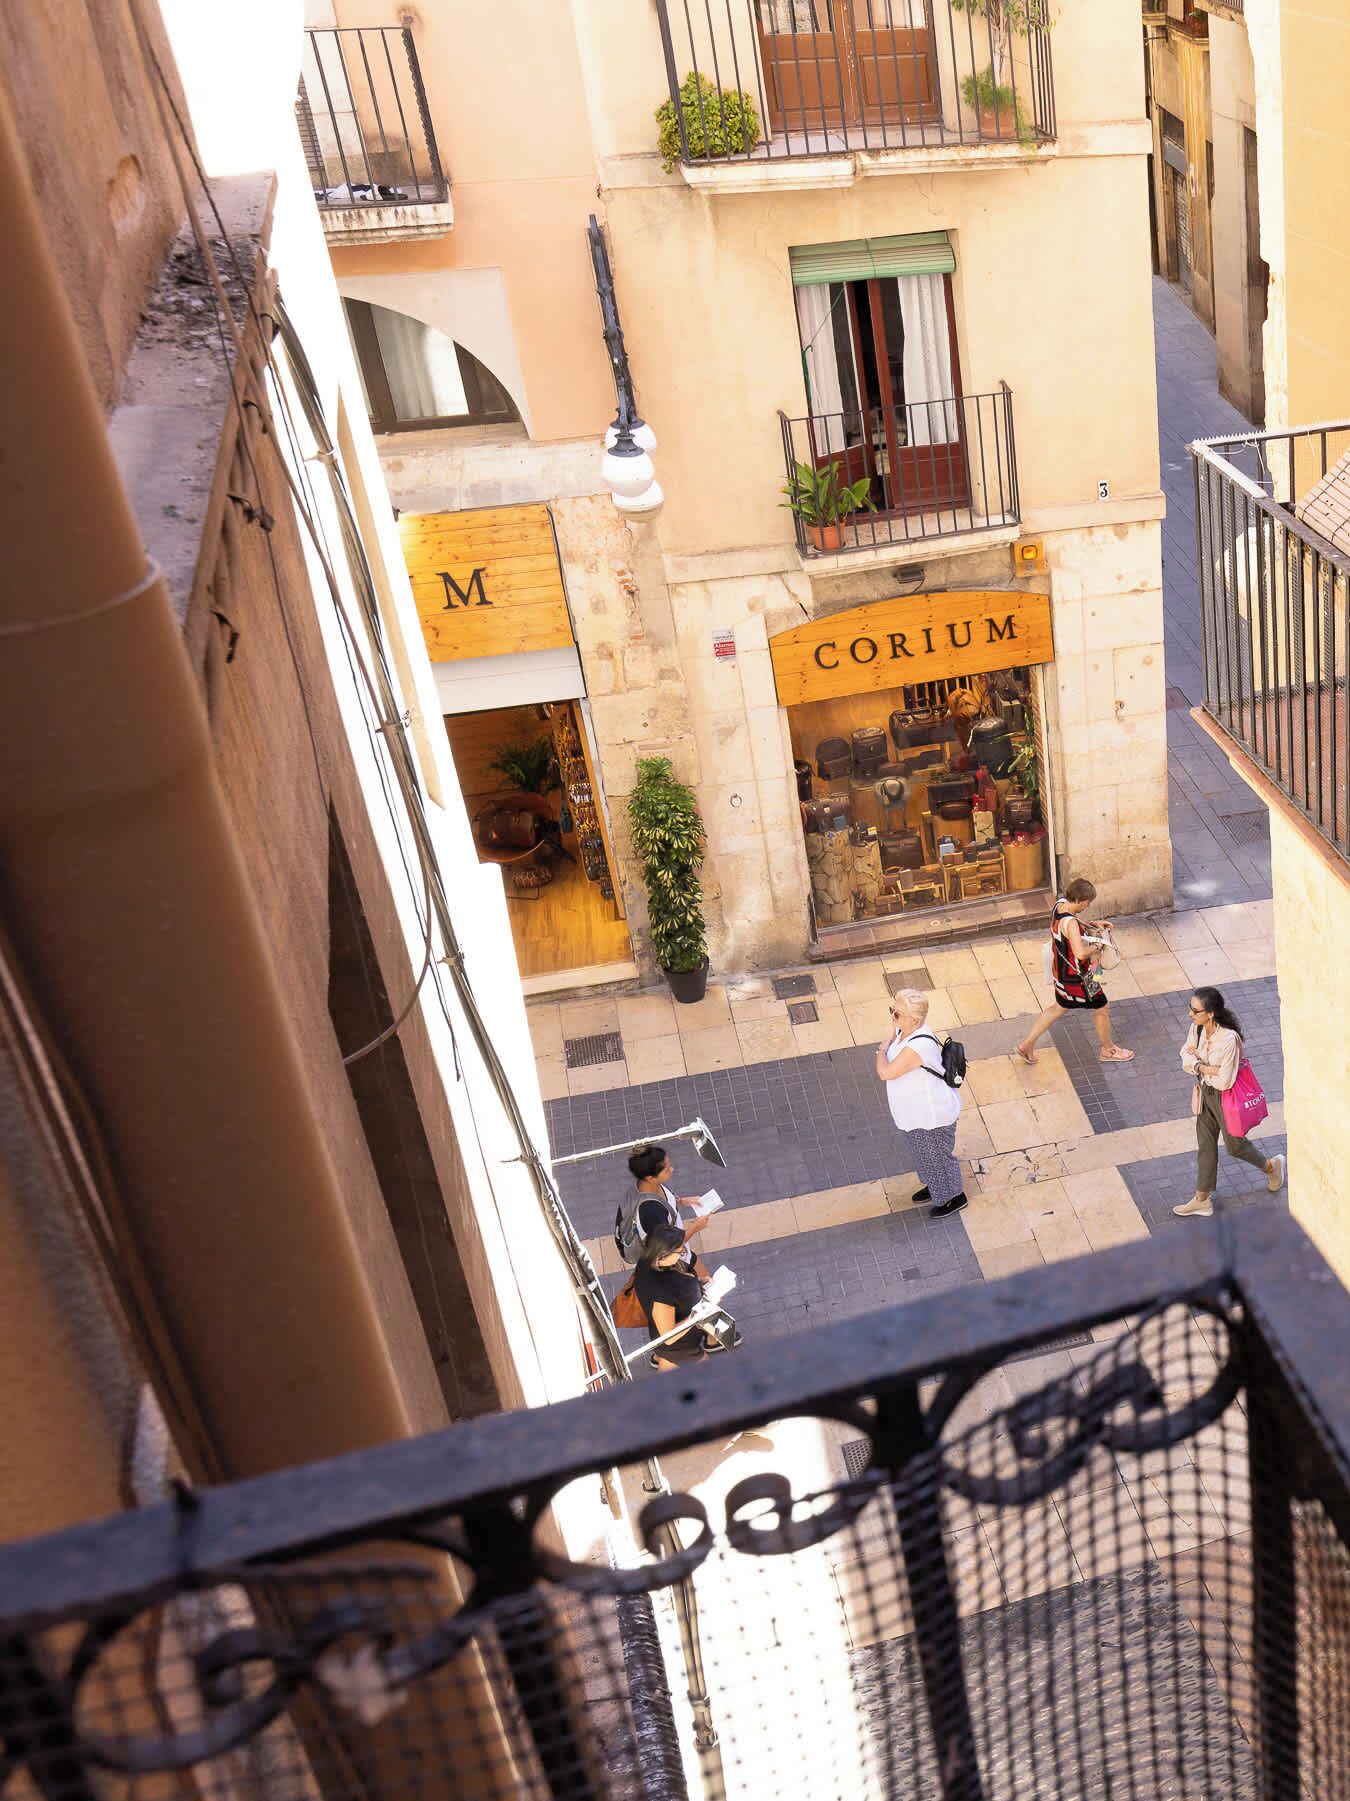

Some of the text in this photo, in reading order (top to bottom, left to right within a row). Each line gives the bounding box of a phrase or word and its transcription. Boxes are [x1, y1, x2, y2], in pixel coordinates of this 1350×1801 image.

[1099, 482, 1108, 498] 3
[409, 566, 494, 610] M
[814, 614, 1018, 670] CORIUM
